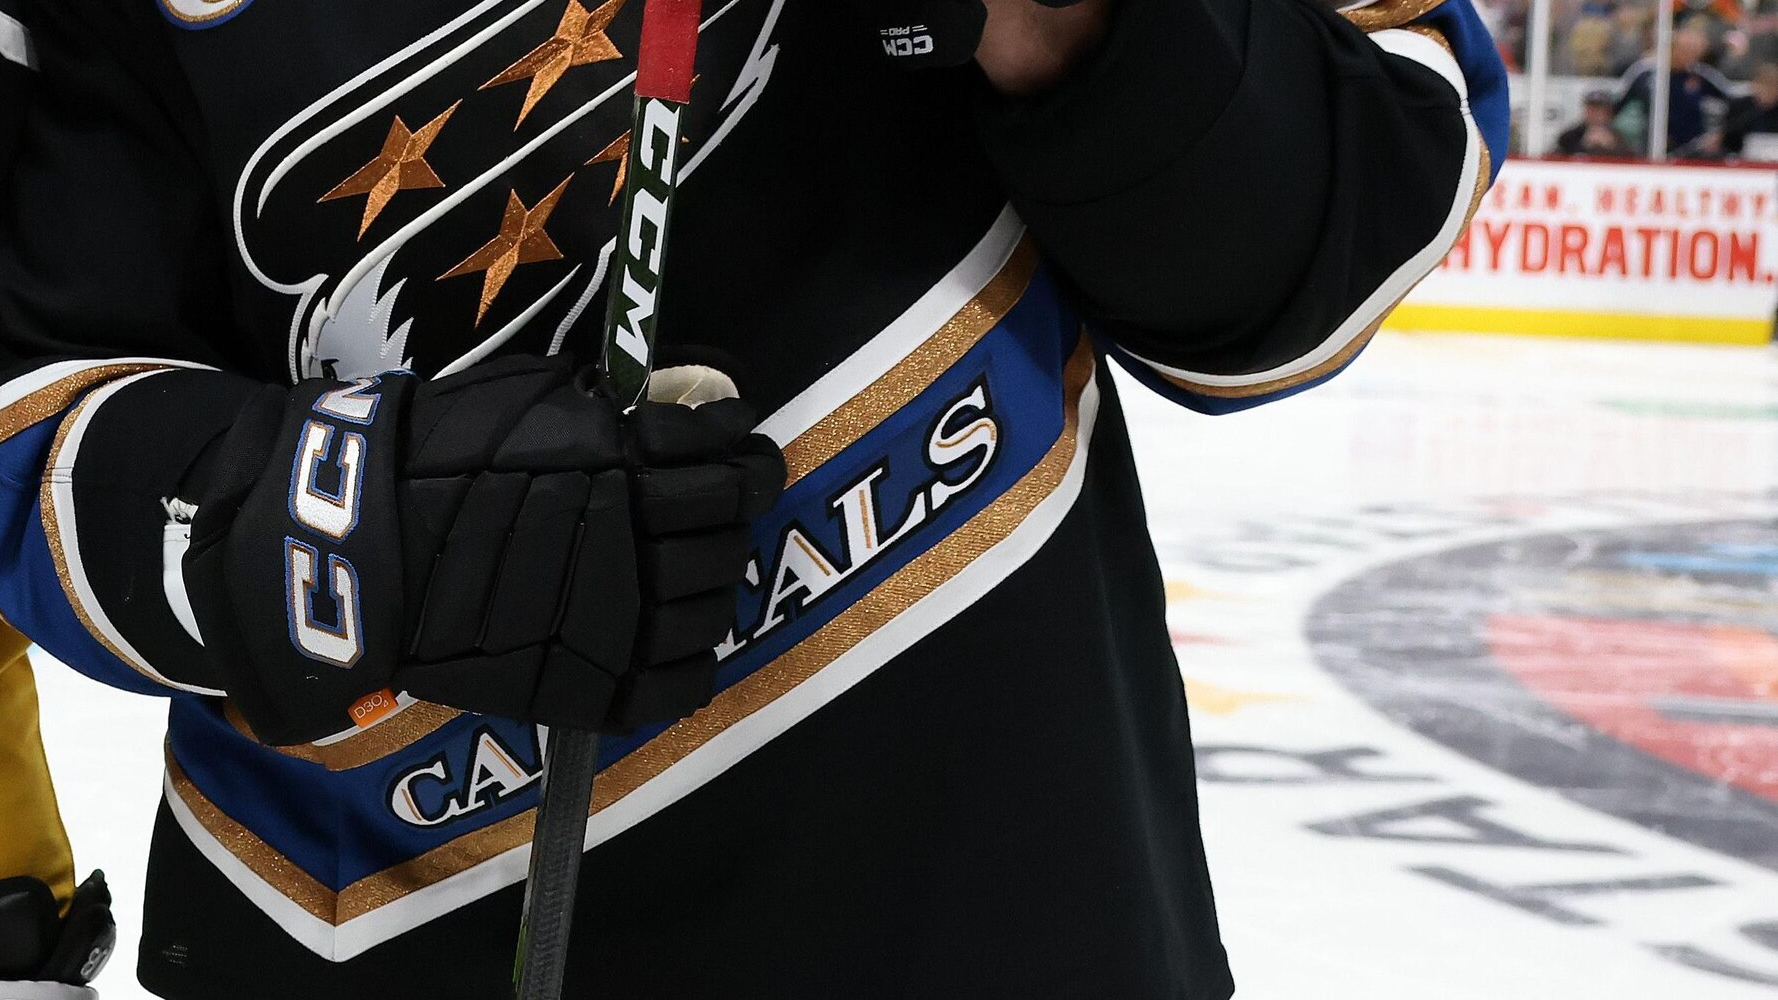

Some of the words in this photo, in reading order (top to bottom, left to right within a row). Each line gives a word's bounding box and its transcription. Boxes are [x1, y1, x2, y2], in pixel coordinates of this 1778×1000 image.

[882, 34, 934, 57] CCM
[1491, 180, 1581, 212] EAN.
[615, 98, 681, 367] CCM
[1441, 221, 1775, 283] HYDRATION.
[284, 372, 384, 670] CCM
